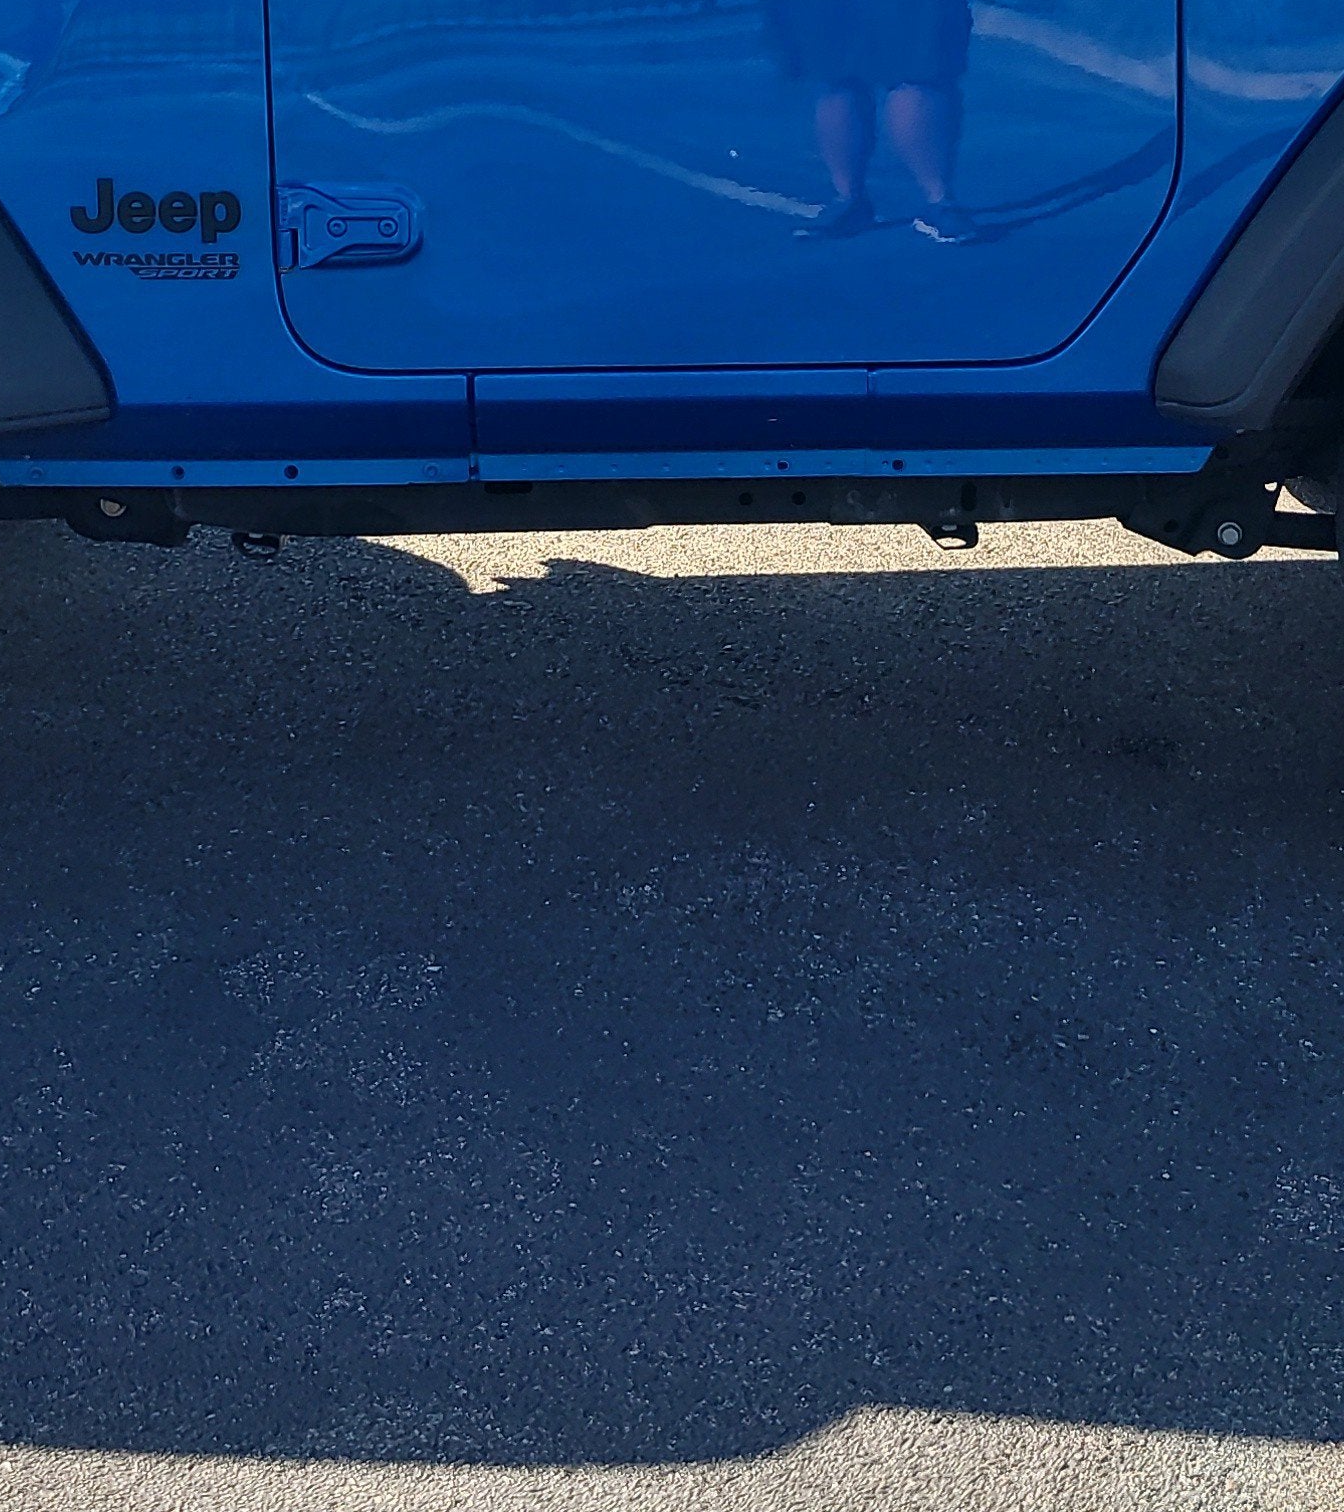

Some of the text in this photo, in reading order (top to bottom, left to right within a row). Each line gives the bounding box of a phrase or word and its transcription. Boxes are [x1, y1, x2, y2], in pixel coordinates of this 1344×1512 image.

[70, 176, 242, 244] Jeep
[72, 251, 240, 266] WRANGLER
[138, 268, 240, 278] SPORT
